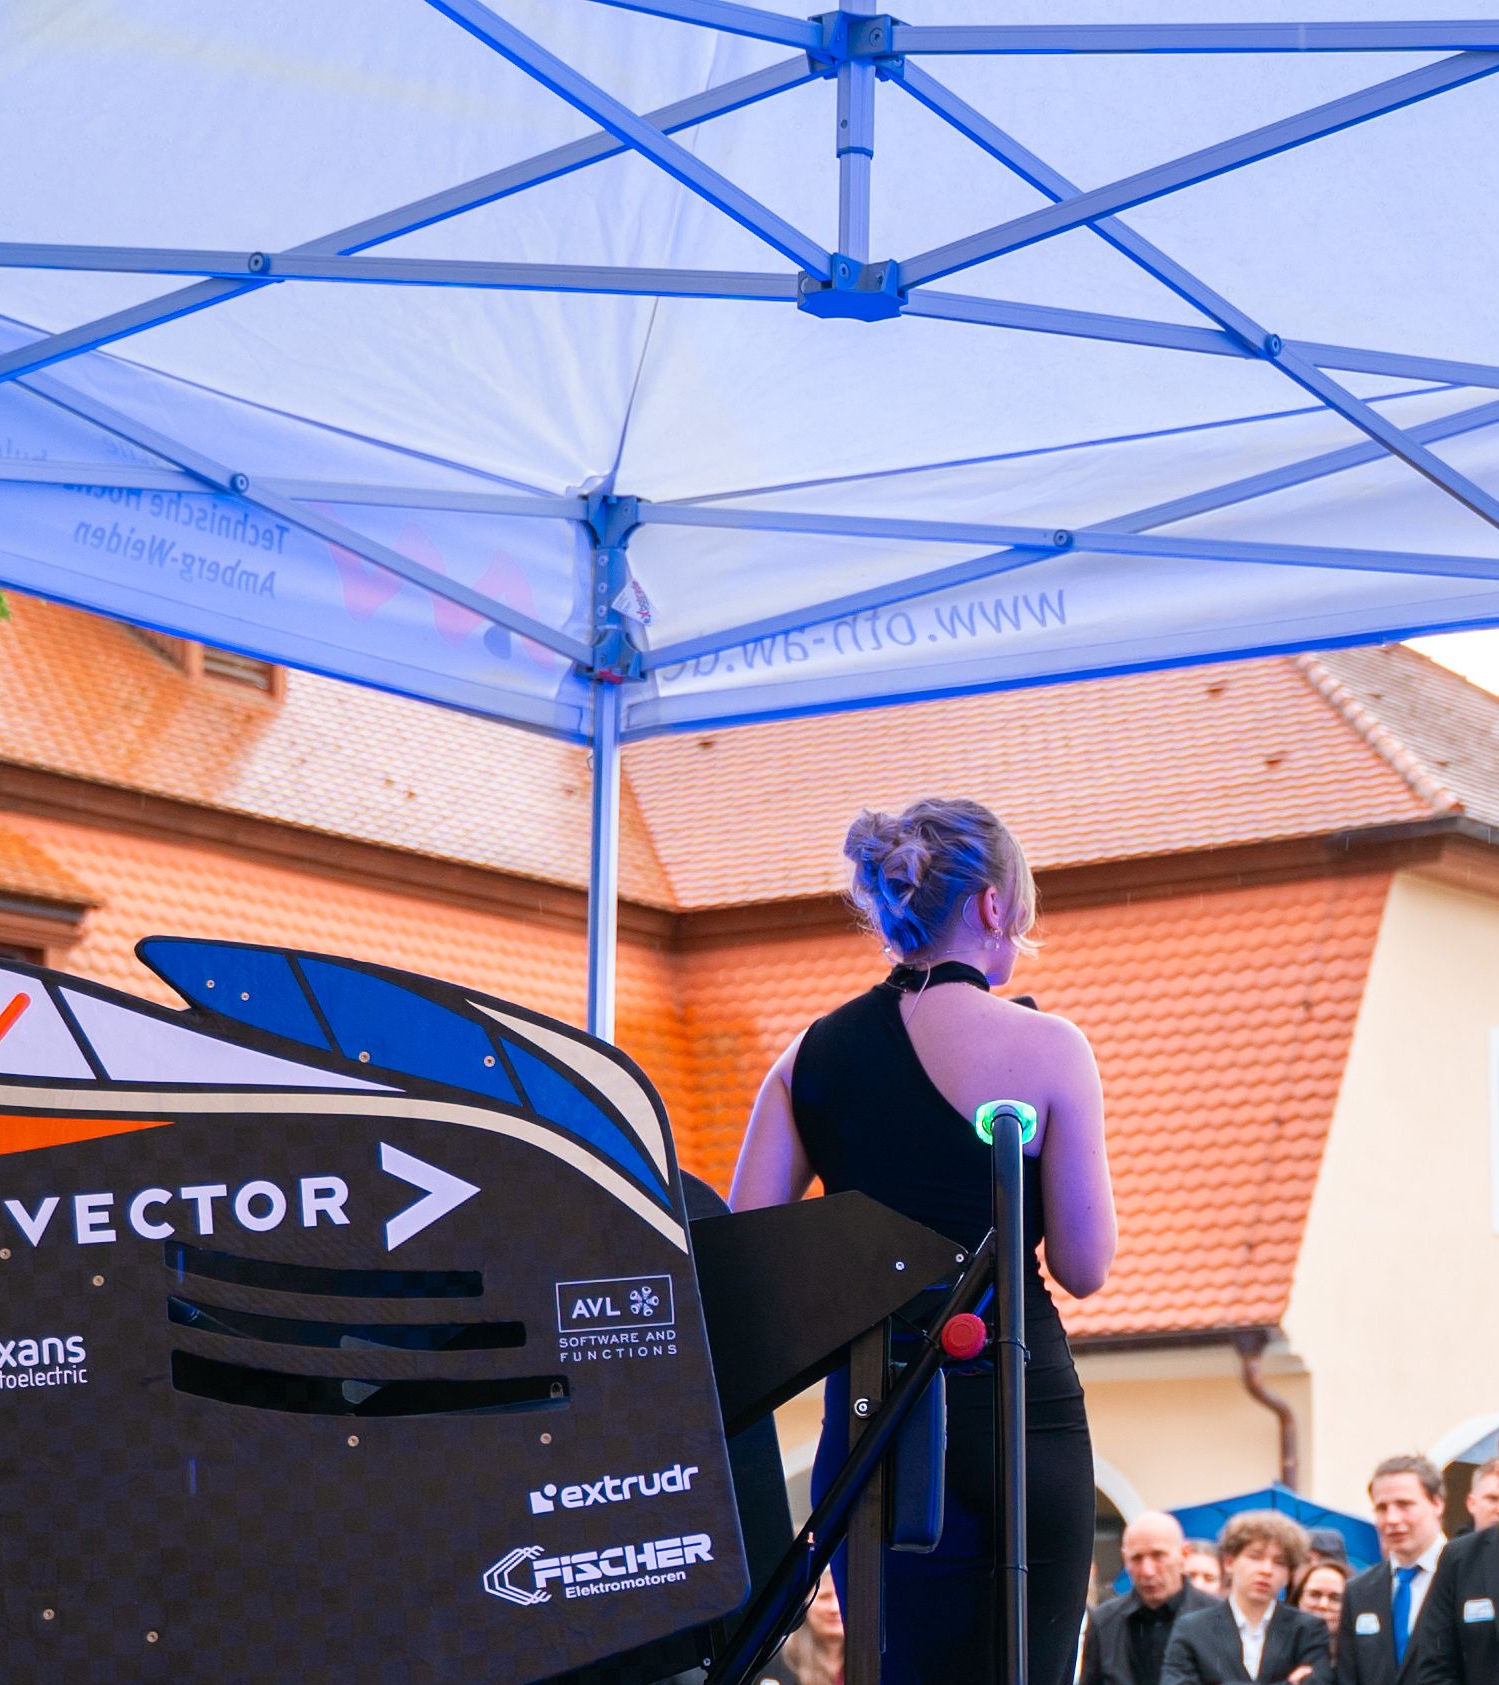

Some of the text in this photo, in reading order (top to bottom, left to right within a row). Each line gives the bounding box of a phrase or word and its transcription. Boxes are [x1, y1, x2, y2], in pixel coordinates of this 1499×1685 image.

[4, 1175, 351, 1248] VECTOR
[571, 1297, 621, 1319] AVL
[558, 1329, 677, 1349] SOFTWARE AND
[560, 1344, 678, 1363] FUNCTIONS
[560, 1463, 699, 1509] extrudr
[565, 1571, 687, 1600] Elektromotoren
